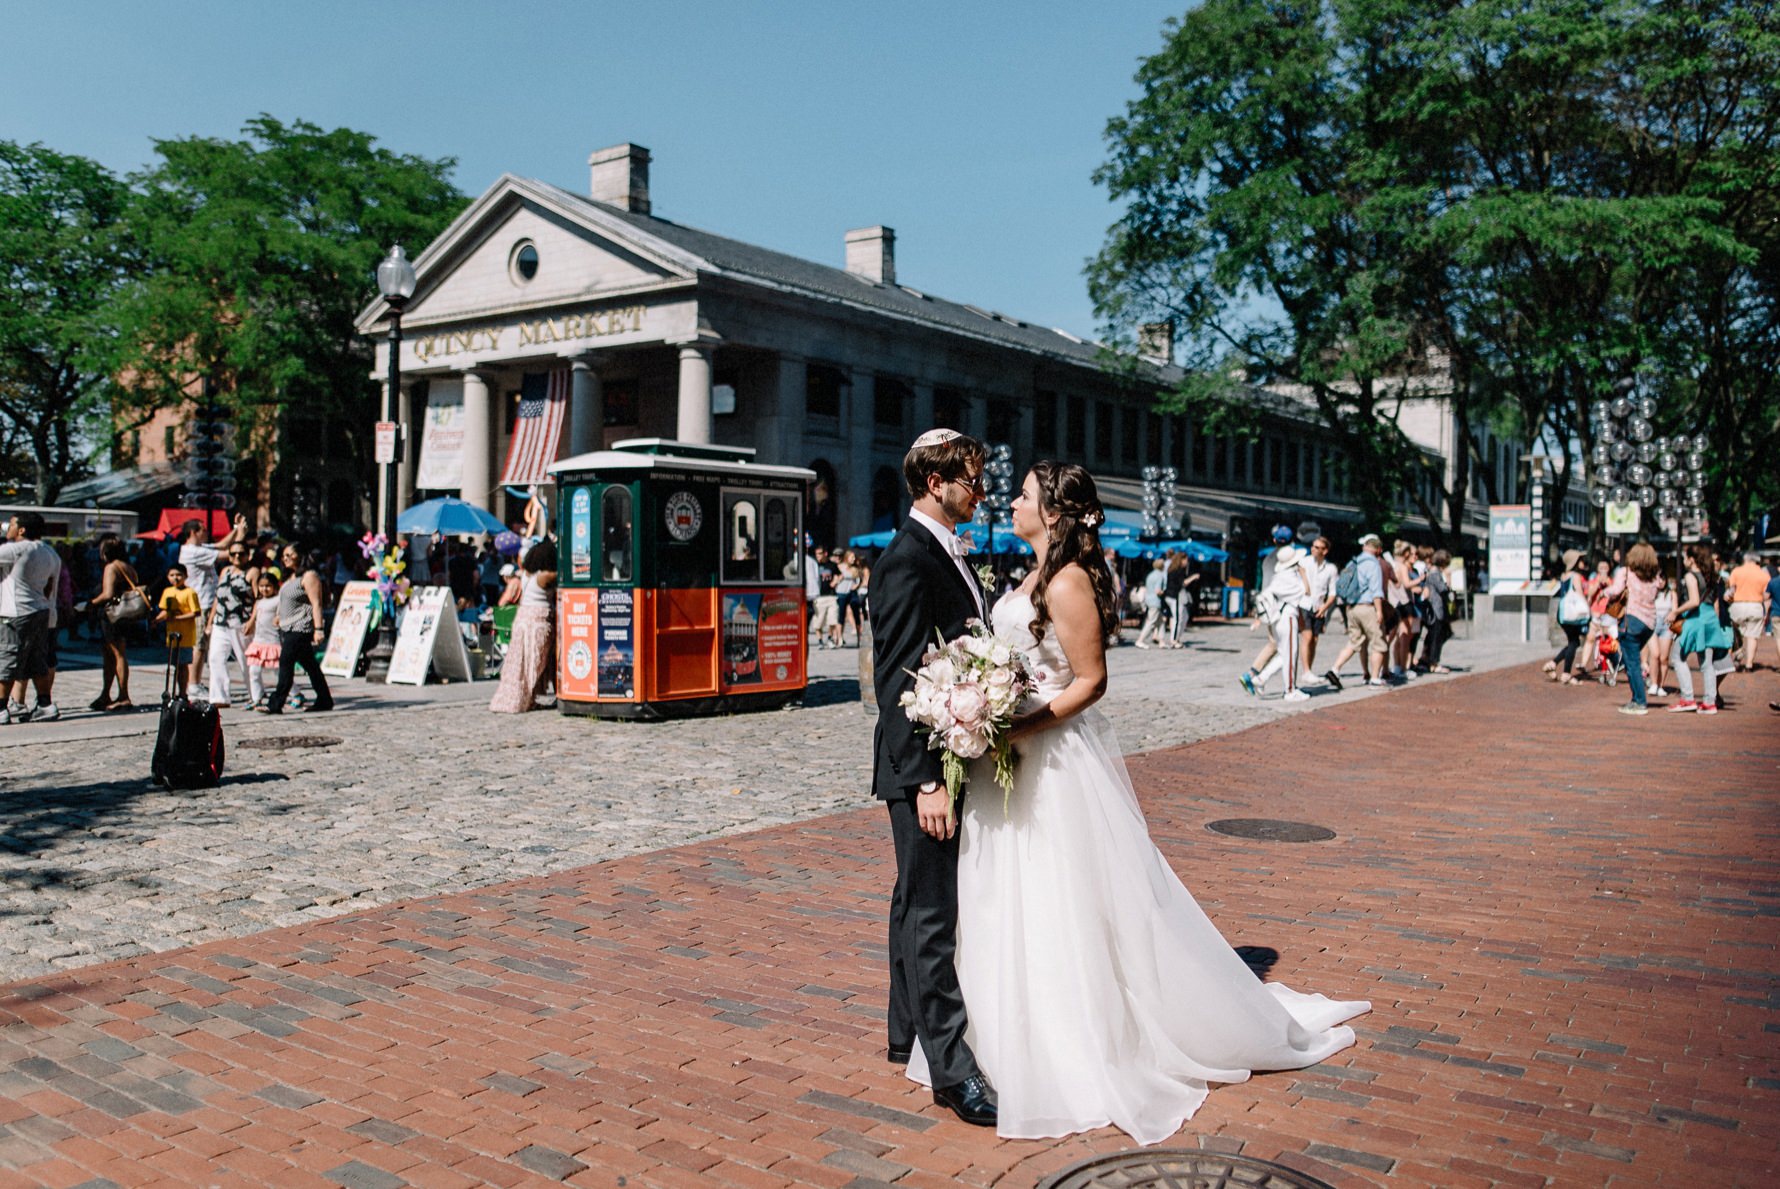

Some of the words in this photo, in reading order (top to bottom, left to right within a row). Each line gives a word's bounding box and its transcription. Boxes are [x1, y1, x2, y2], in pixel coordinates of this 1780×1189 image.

[414, 326, 504, 363] QUINCY
[518, 305, 648, 347] MARKET
[573, 602, 587, 612] BUY
[567, 614, 593, 625] TICKETS
[571, 626, 589, 637] HERE
